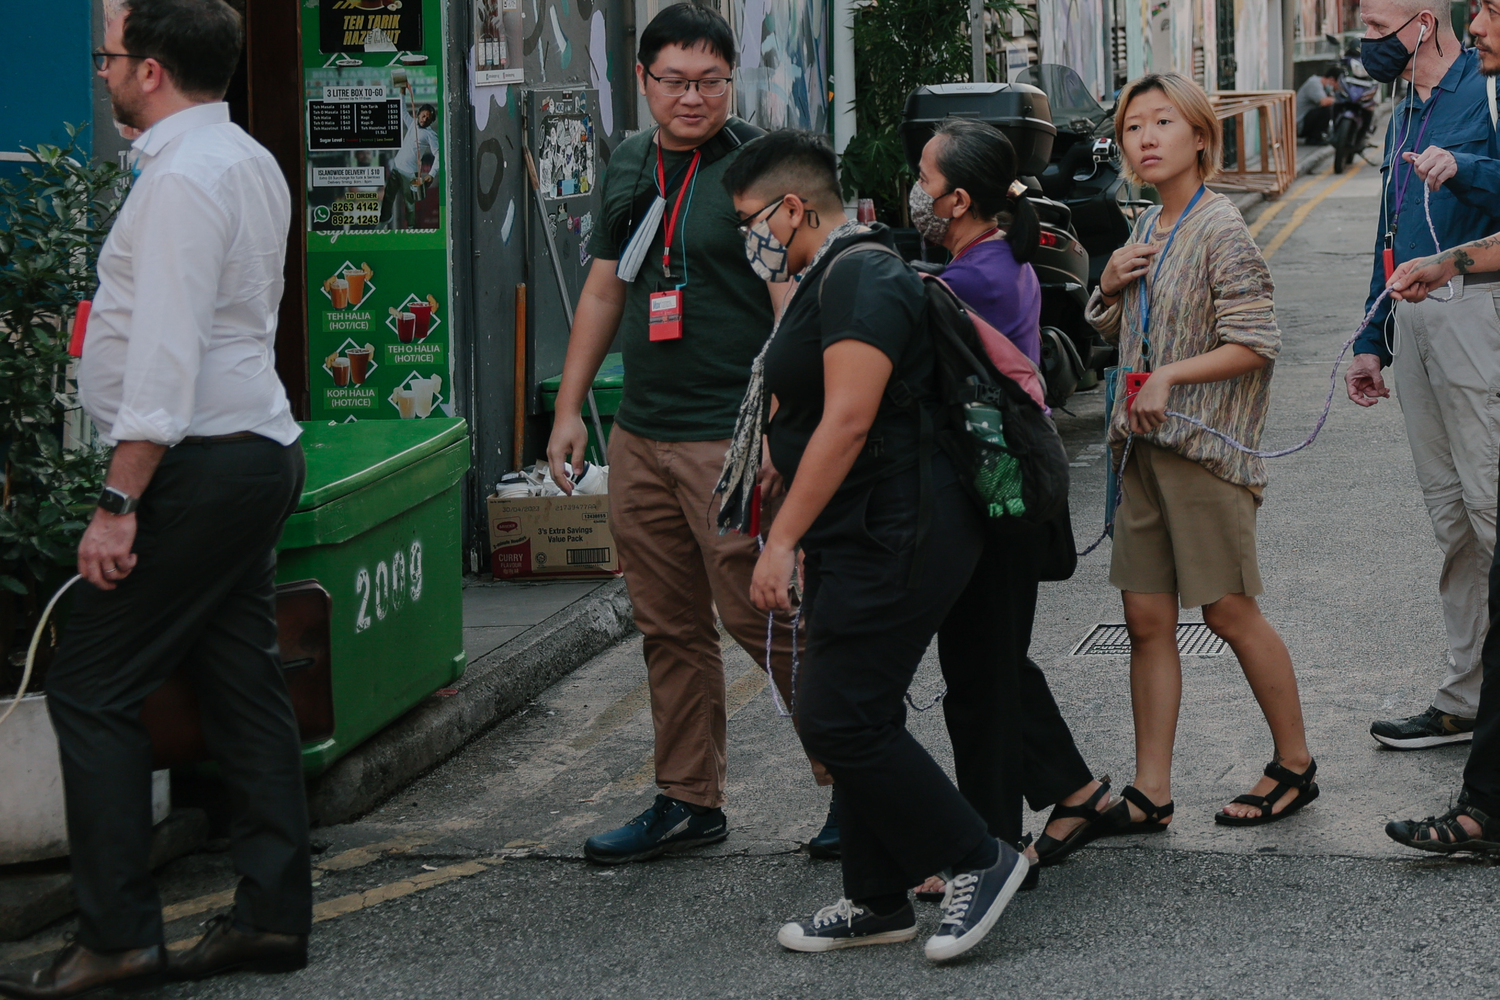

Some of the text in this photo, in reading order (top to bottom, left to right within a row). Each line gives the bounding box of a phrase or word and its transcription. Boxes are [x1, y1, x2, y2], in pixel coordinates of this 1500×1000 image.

[343, 14, 401, 30] TEH TARIK
[327, 88, 383, 97] 3 LITRE BOX TO-GO
[332, 202, 379, 212] 8263 4142
[332, 215, 379, 224] 8922 1243
[329, 321, 369, 330] (HOT/ICE)
[394, 354, 434, 363] (HOT/ICE)
[348, 389, 375, 397] HALIA
[331, 398, 371, 408] (HOT/ICE)
[567, 526, 593, 535] Savings
[498, 554, 524, 562] CURRY
[355, 541, 423, 634] 2009
